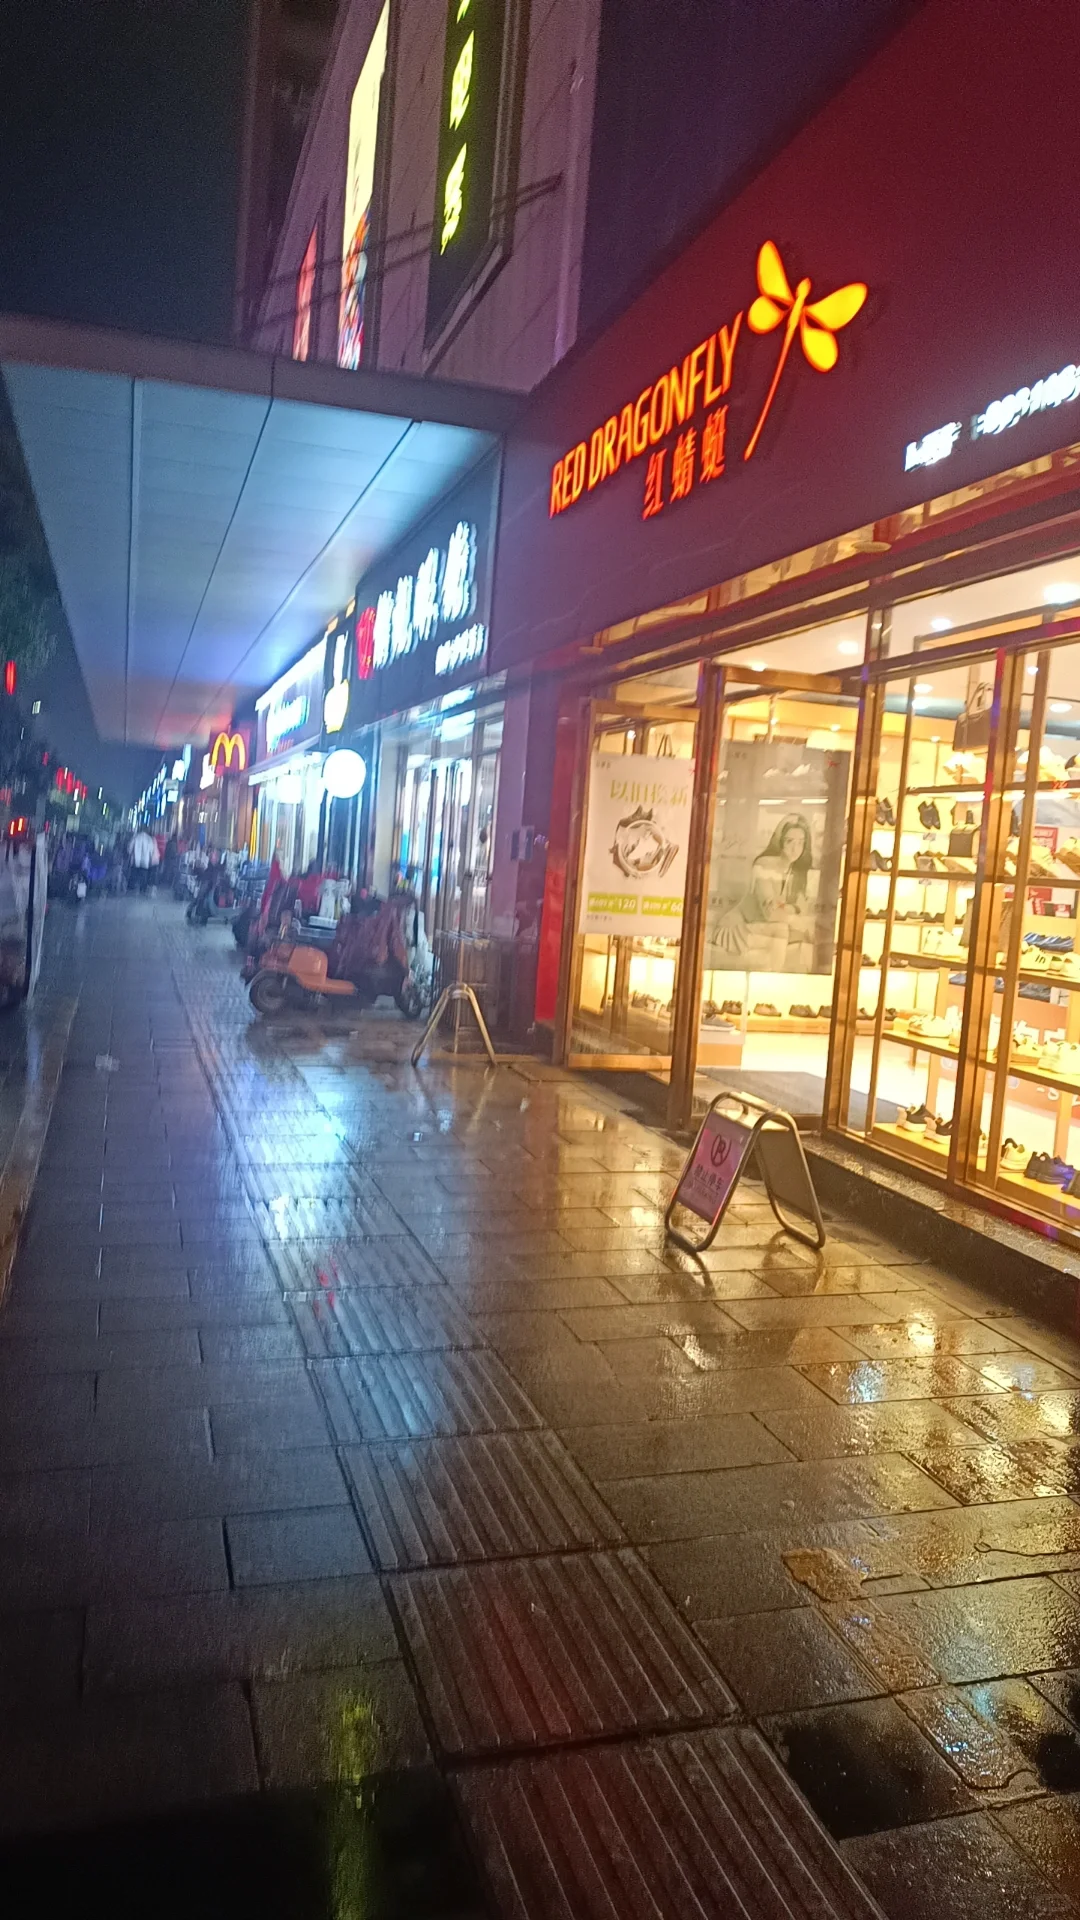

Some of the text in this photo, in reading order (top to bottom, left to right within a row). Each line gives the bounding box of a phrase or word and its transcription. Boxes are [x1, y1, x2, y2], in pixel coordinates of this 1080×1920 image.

[549, 311, 742, 519] RED DRAGONFLY
[642, 404, 728, 520] 红蜻蜓
